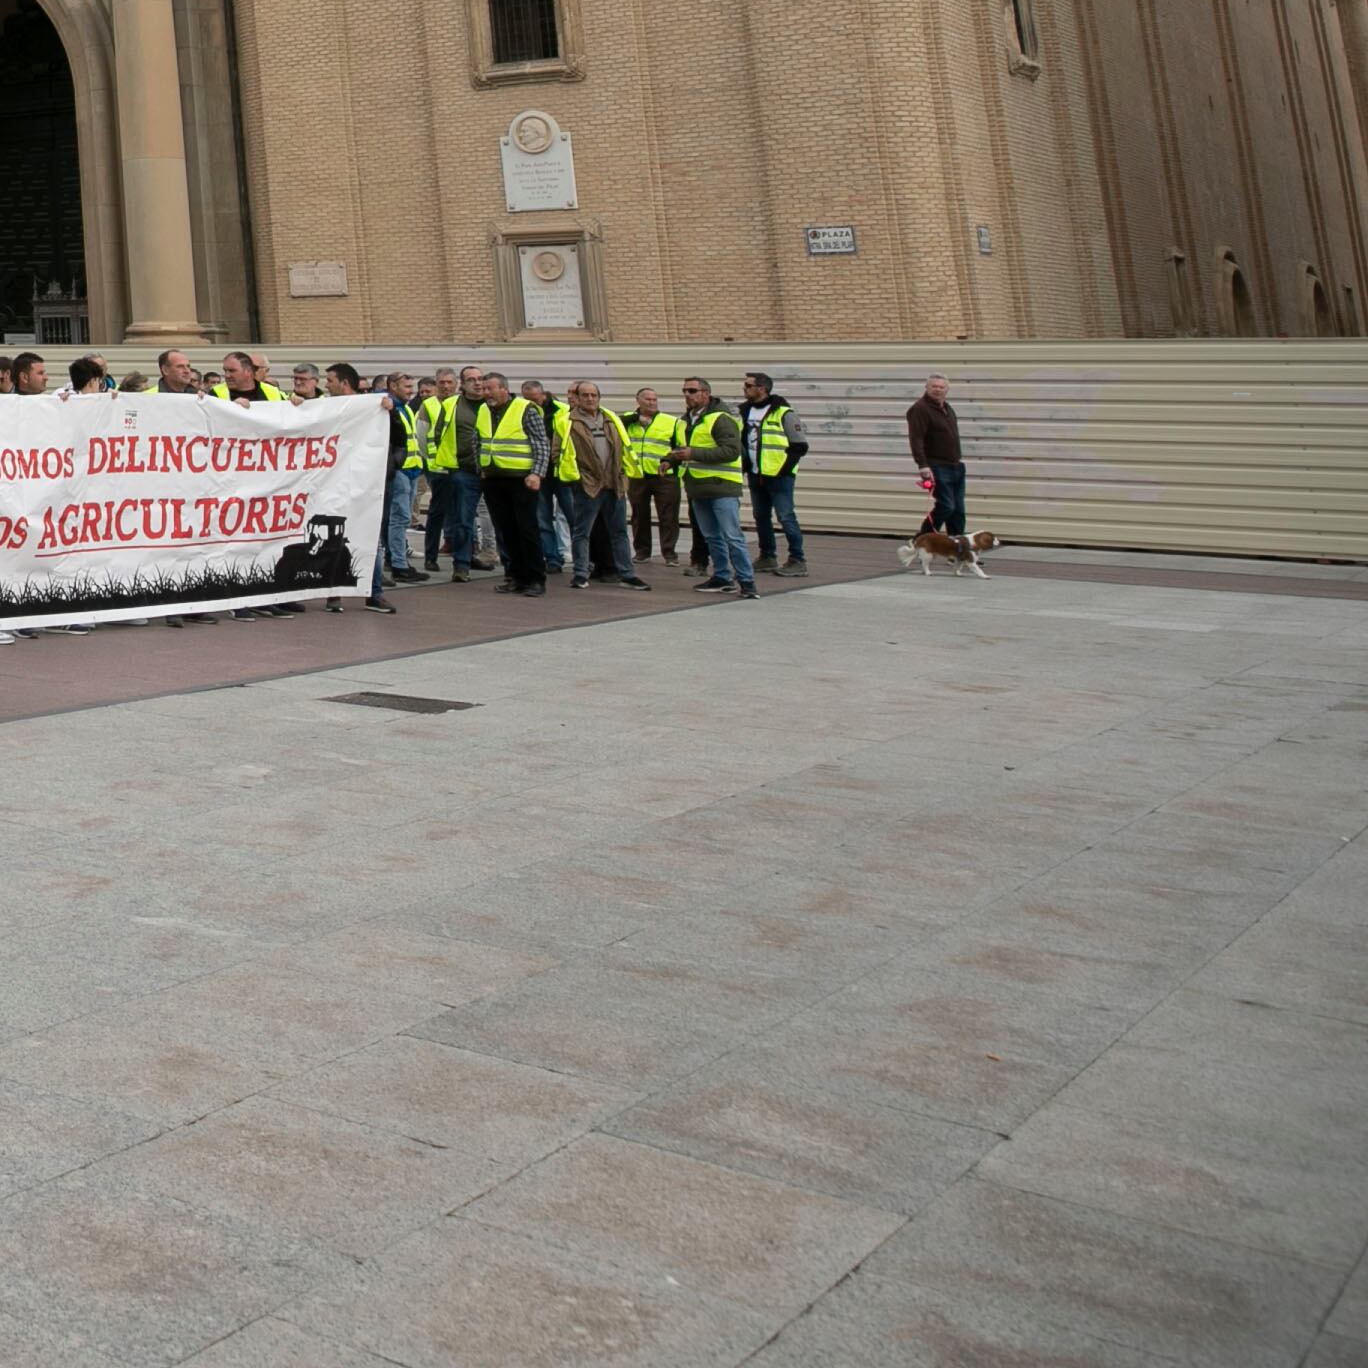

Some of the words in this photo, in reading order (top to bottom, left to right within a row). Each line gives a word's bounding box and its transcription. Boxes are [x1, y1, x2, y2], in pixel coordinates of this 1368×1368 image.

[821, 230, 851, 238] PLAZA
[87, 435, 338, 476] DELINCUENTES
[37, 493, 307, 551] AGRICULTORES
